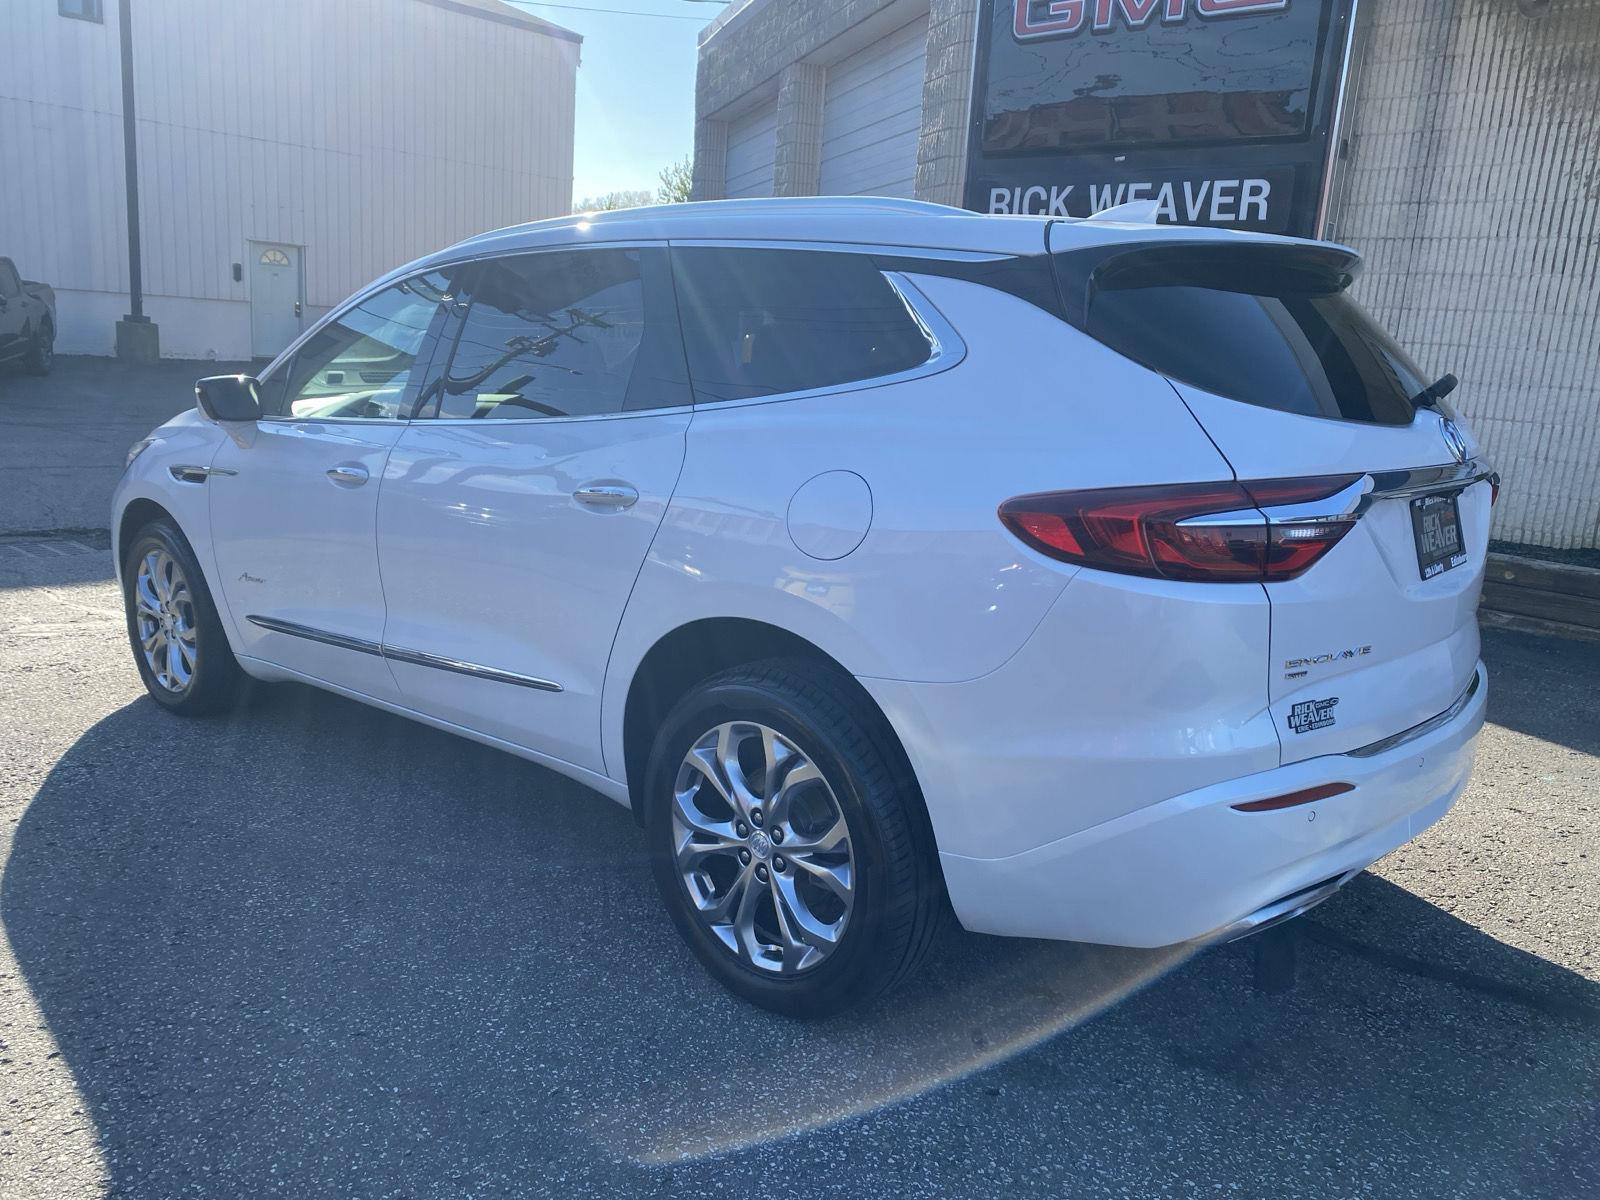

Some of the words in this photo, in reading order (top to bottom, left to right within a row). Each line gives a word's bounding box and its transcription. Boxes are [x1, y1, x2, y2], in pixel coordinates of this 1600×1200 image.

[1013, 0, 1288, 39] GM
[988, 185, 1075, 217] RICK
[1423, 513, 1442, 533] RICK
[1421, 525, 1457, 554] WEAVER
[1290, 707, 1334, 728] WEAVER
[1294, 701, 1316, 716] RICK
